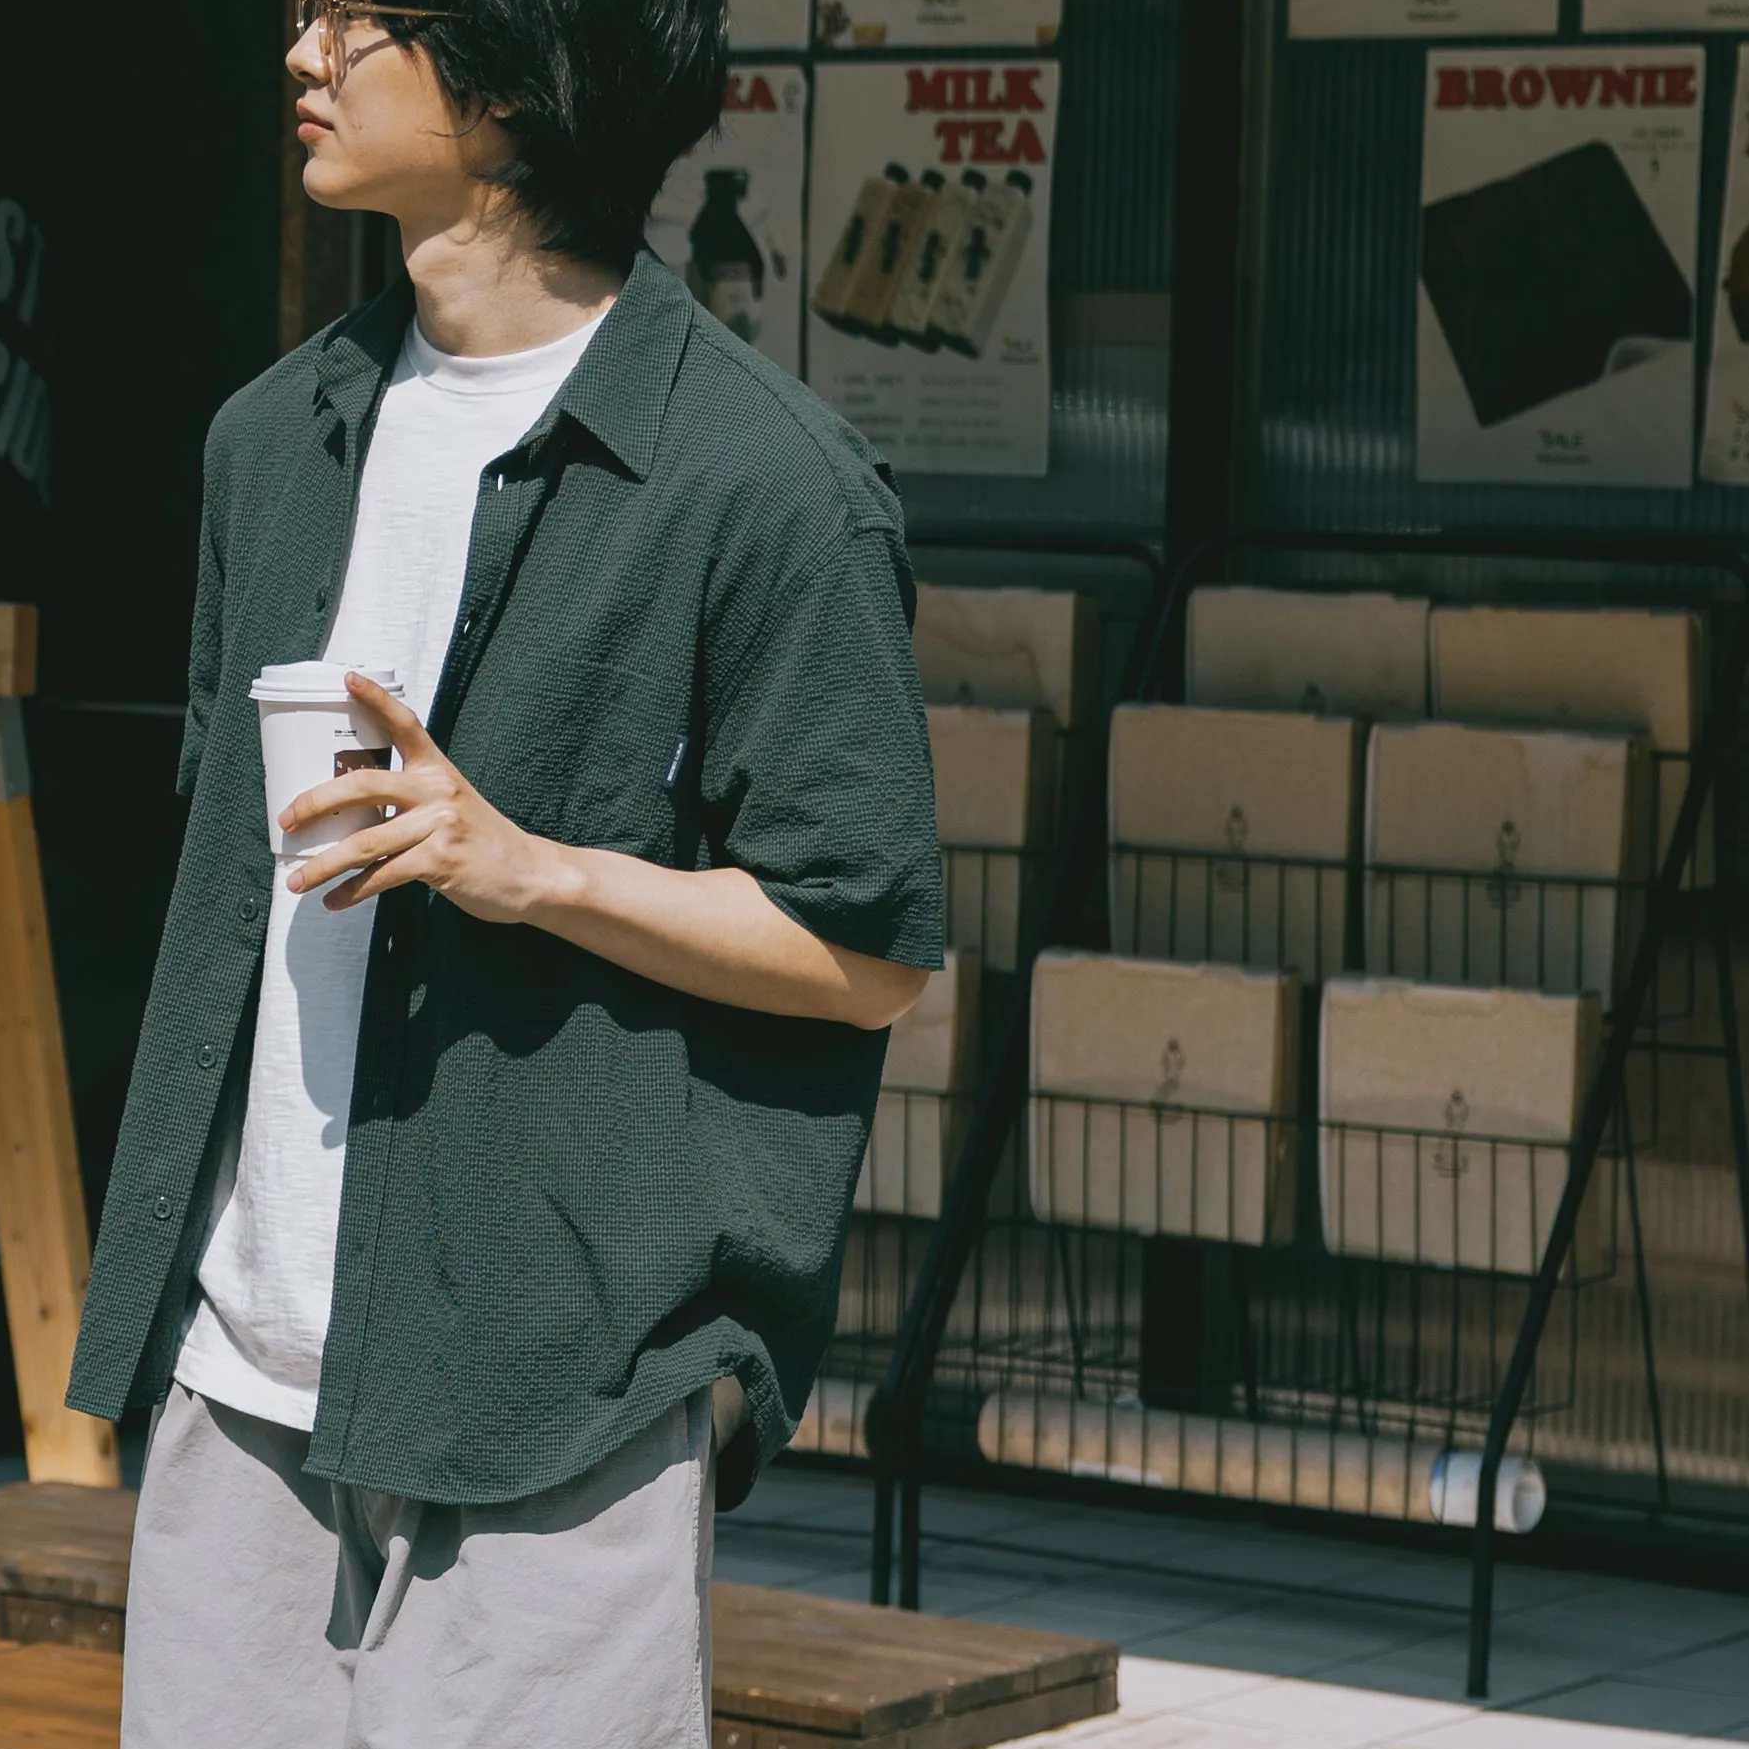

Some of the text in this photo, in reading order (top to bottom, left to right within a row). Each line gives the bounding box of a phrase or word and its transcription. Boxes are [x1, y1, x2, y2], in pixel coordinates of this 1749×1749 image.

[905, 69, 1045, 114] MILK
[1434, 65, 1697, 111] BROWNIE
[935, 119, 1047, 164] TEA
